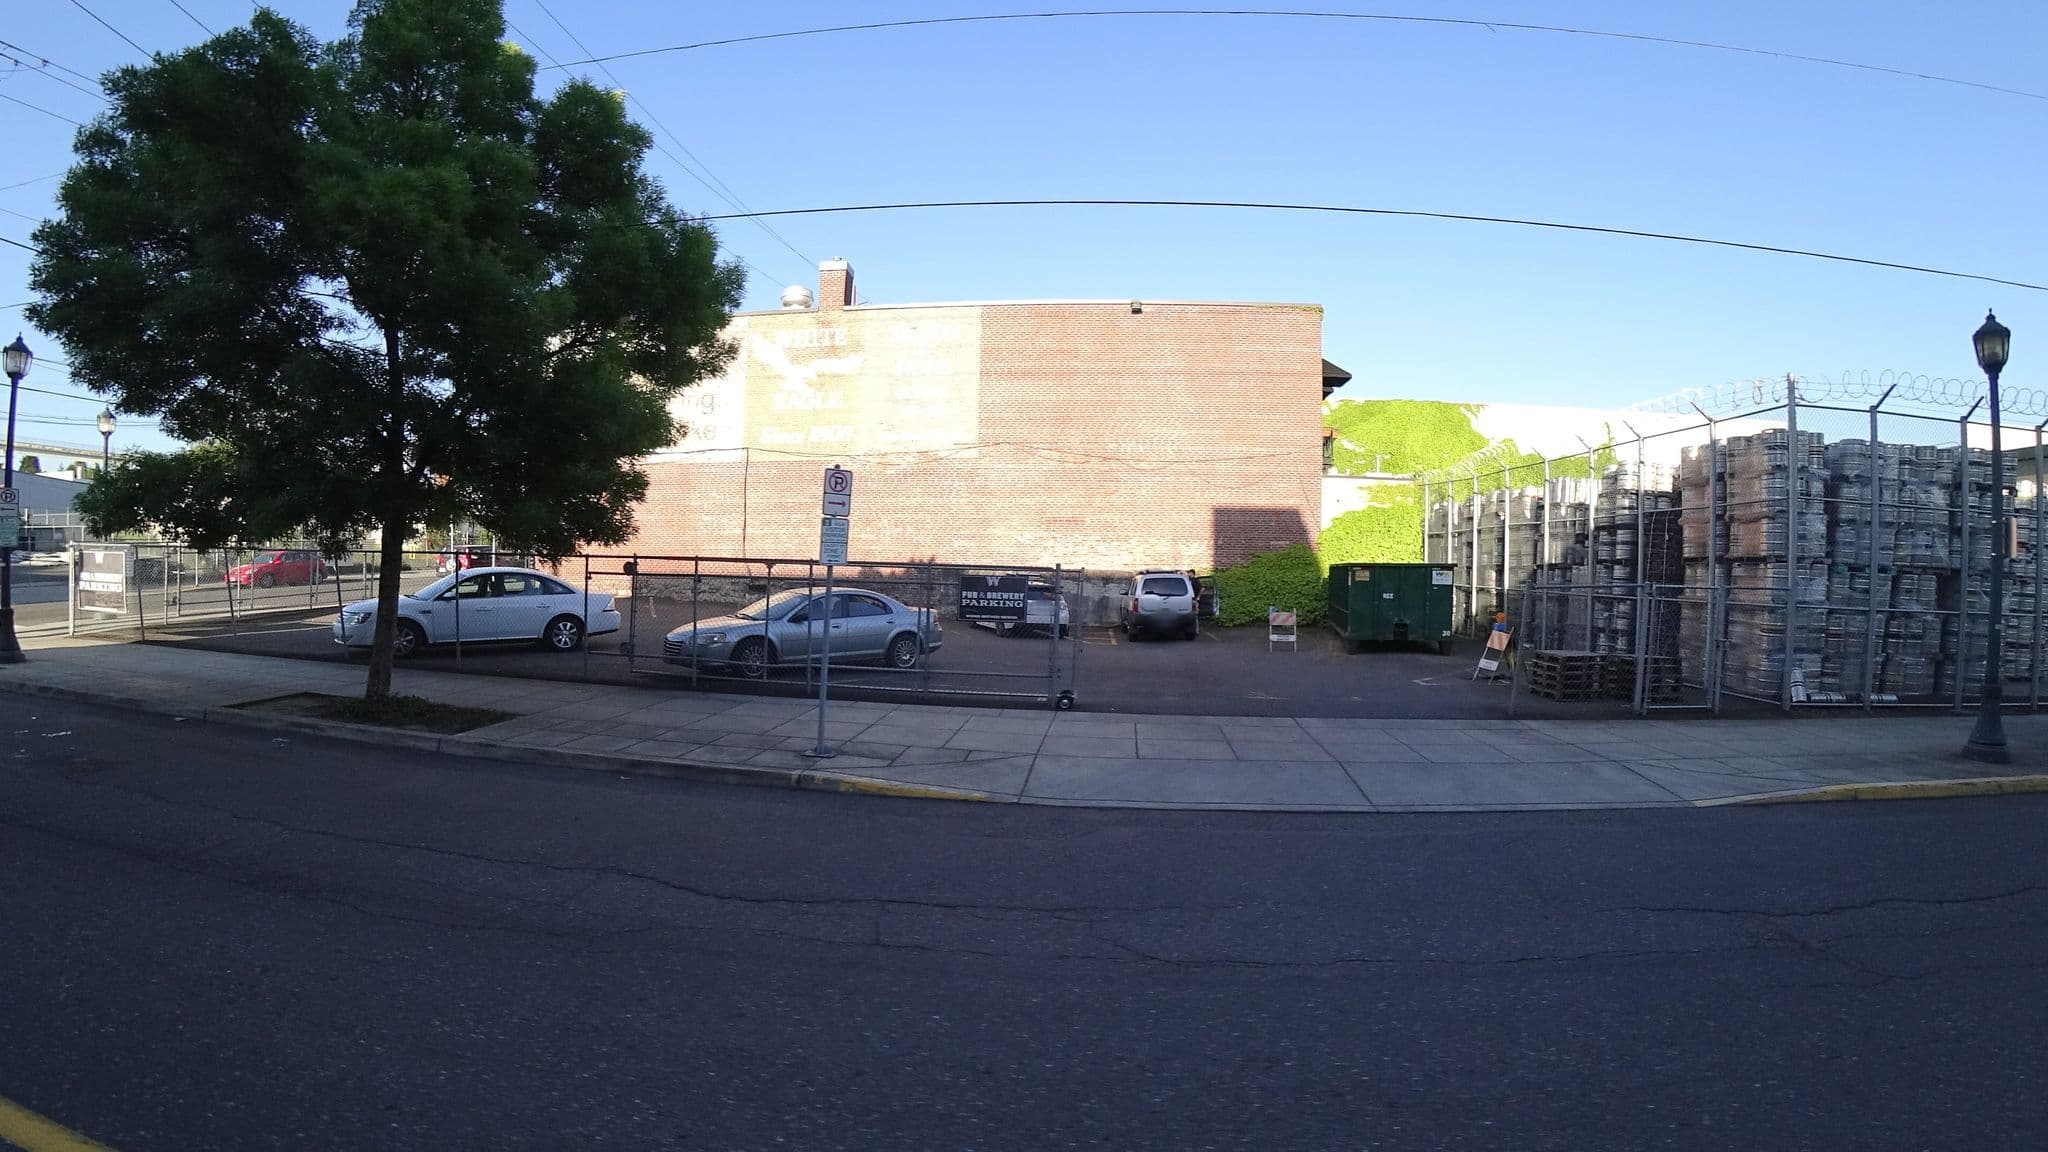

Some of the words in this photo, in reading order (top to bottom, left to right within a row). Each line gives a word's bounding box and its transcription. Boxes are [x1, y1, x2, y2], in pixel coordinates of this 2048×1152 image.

[79, 581, 122, 593] PARKING
[961, 591, 978, 599] PUB
[986, 591, 1025, 600] BREWERY
[960, 599, 1024, 608] PARKING
